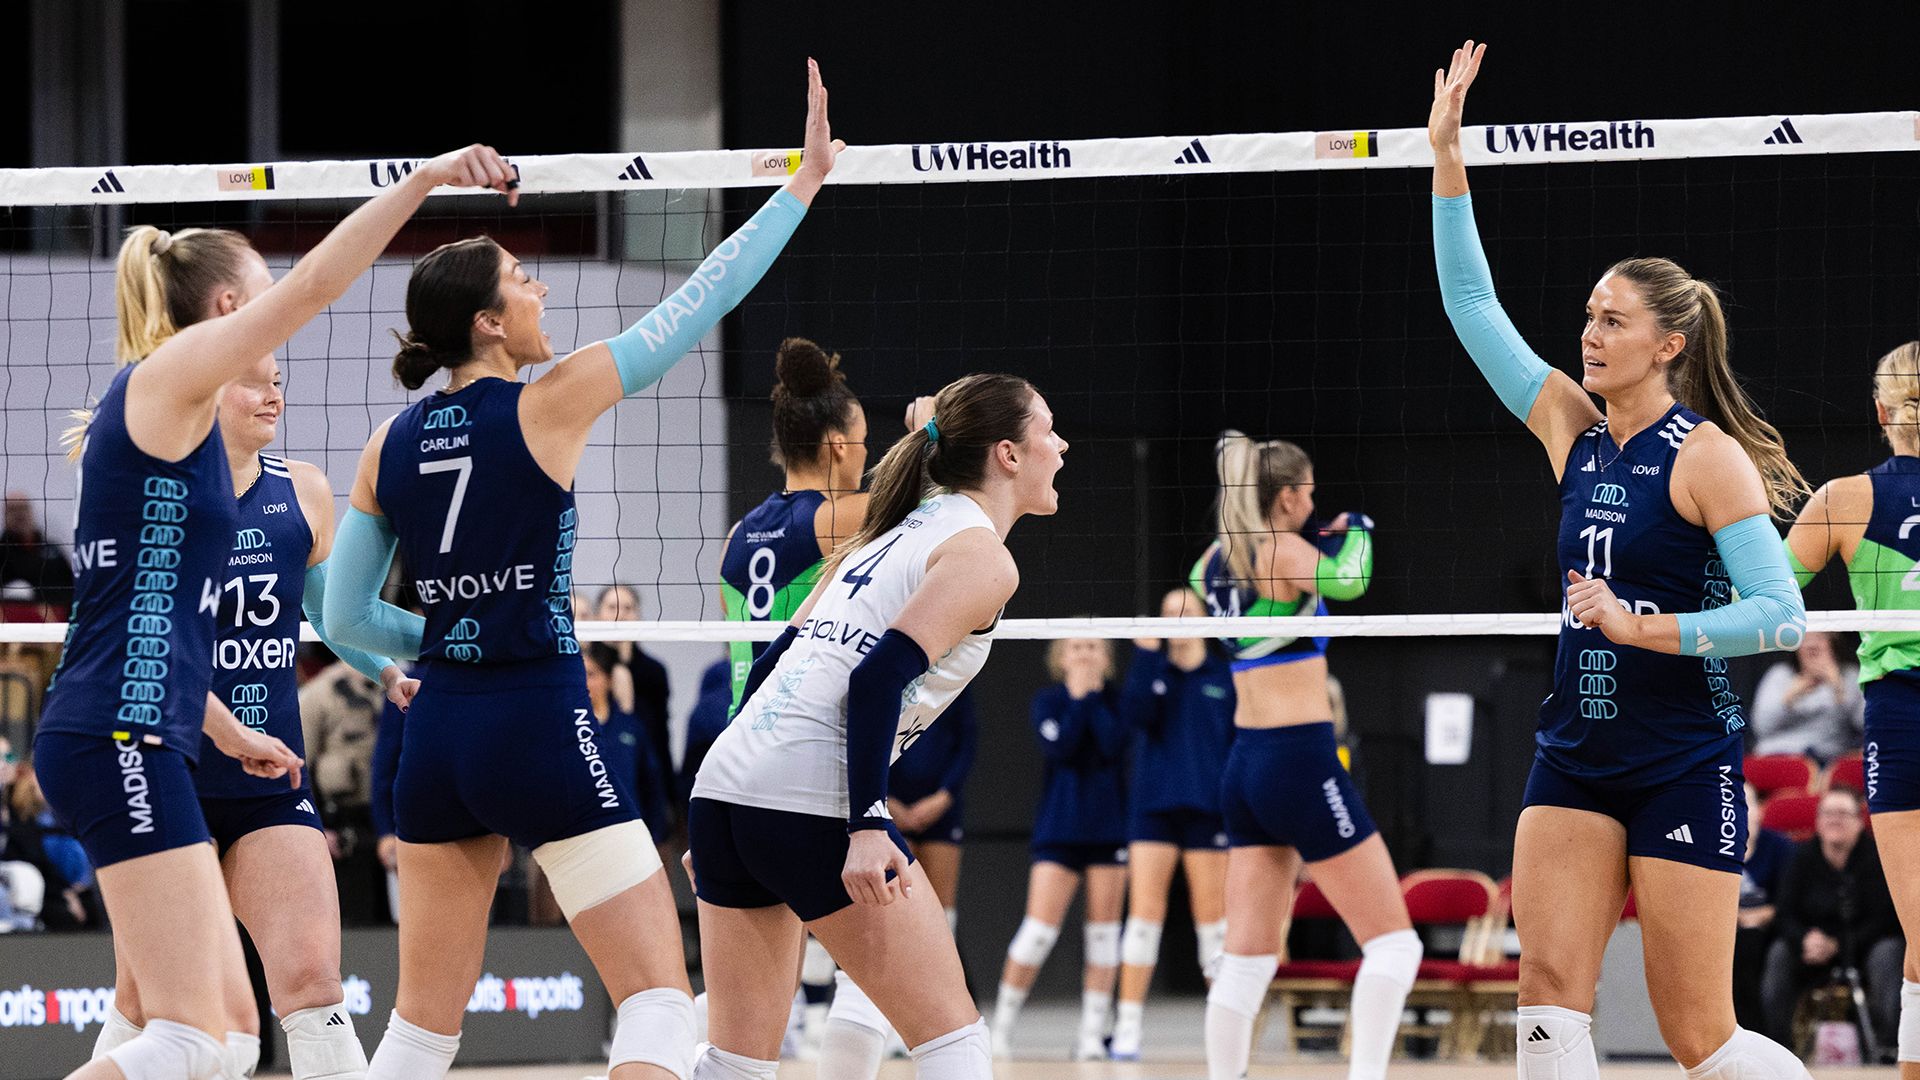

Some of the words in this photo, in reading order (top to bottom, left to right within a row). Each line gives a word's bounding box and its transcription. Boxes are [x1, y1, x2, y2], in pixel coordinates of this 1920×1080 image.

[764, 157, 791, 168] LOVB
[1329, 139, 1357, 150] LOVB
[229, 172, 255, 183] LOVB
[420, 434, 469, 452] CARLINI
[1631, 464, 1660, 476] LOVB
[262, 502, 288, 515] LOVB
[418, 456, 473, 554] 7
[1584, 508, 1627, 524] MADISON
[841, 533, 903, 600] 4
[1579, 524, 1614, 580] 11
[224, 573, 281, 627] 13
[747, 547, 776, 619] 8
[573, 708, 620, 808] MADISON
[115, 740, 155, 834] MADISO
[1718, 764, 1737, 856] MADISON
